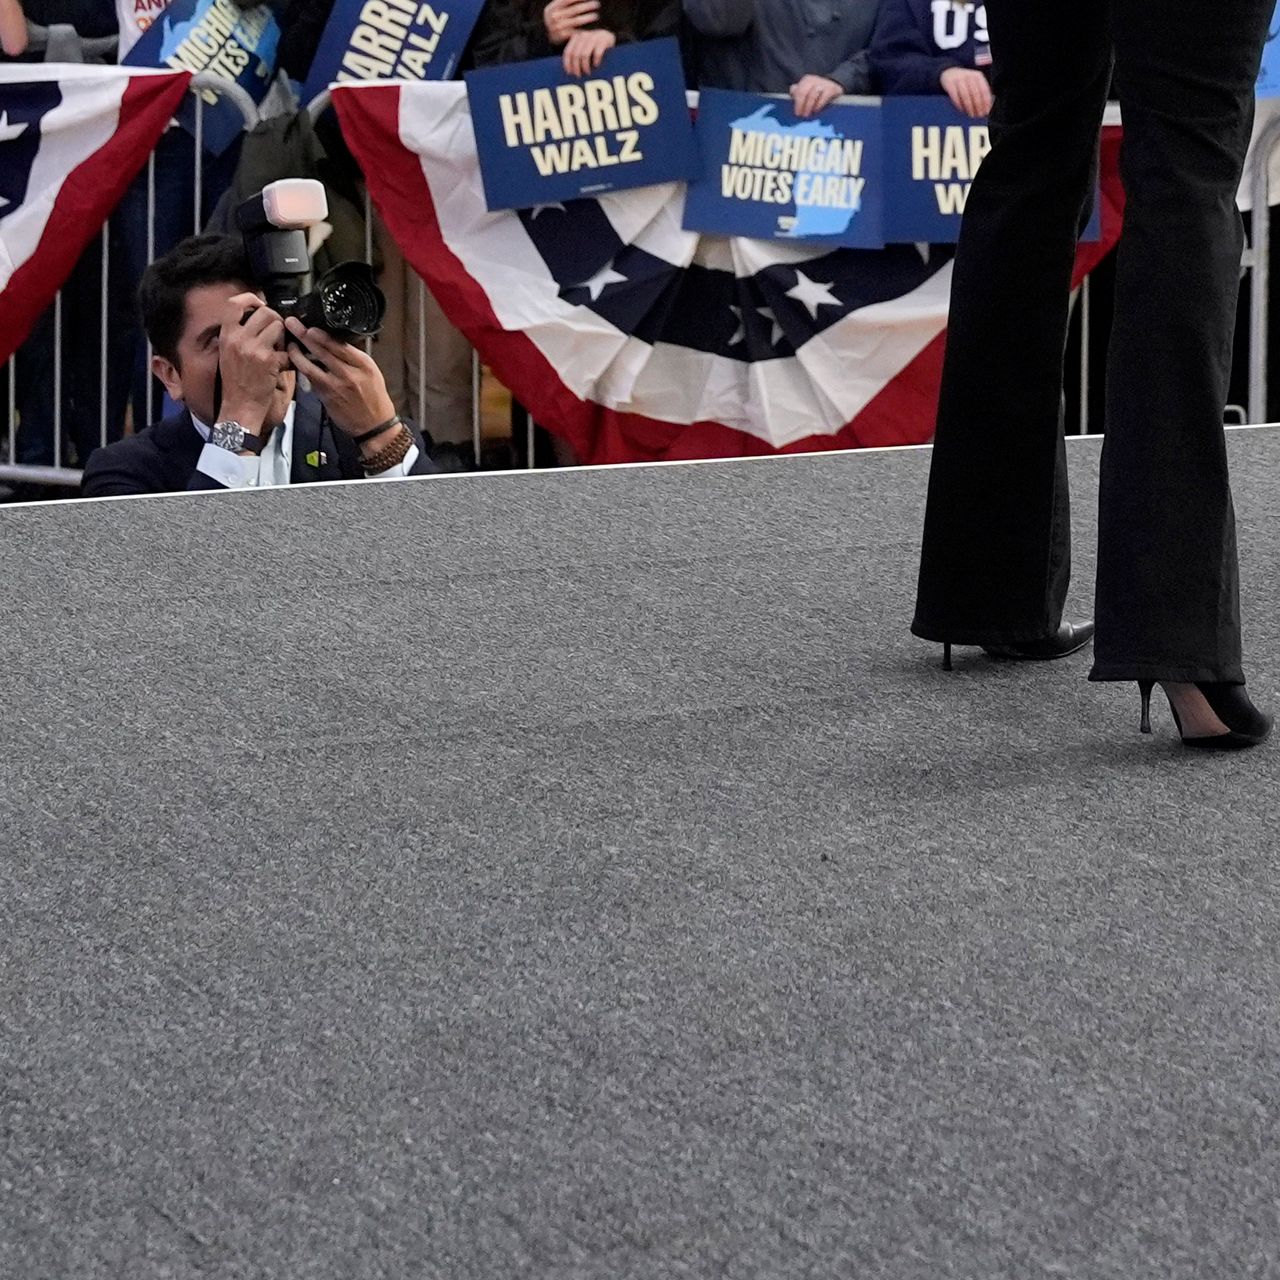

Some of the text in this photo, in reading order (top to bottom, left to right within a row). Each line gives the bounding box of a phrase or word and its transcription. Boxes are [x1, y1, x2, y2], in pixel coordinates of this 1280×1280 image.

[499, 71, 660, 148] HARRIS
[530, 129, 643, 177] WALZ
[728, 127, 864, 177] MICHIGAN
[721, 163, 866, 210] VOTES EARLY
